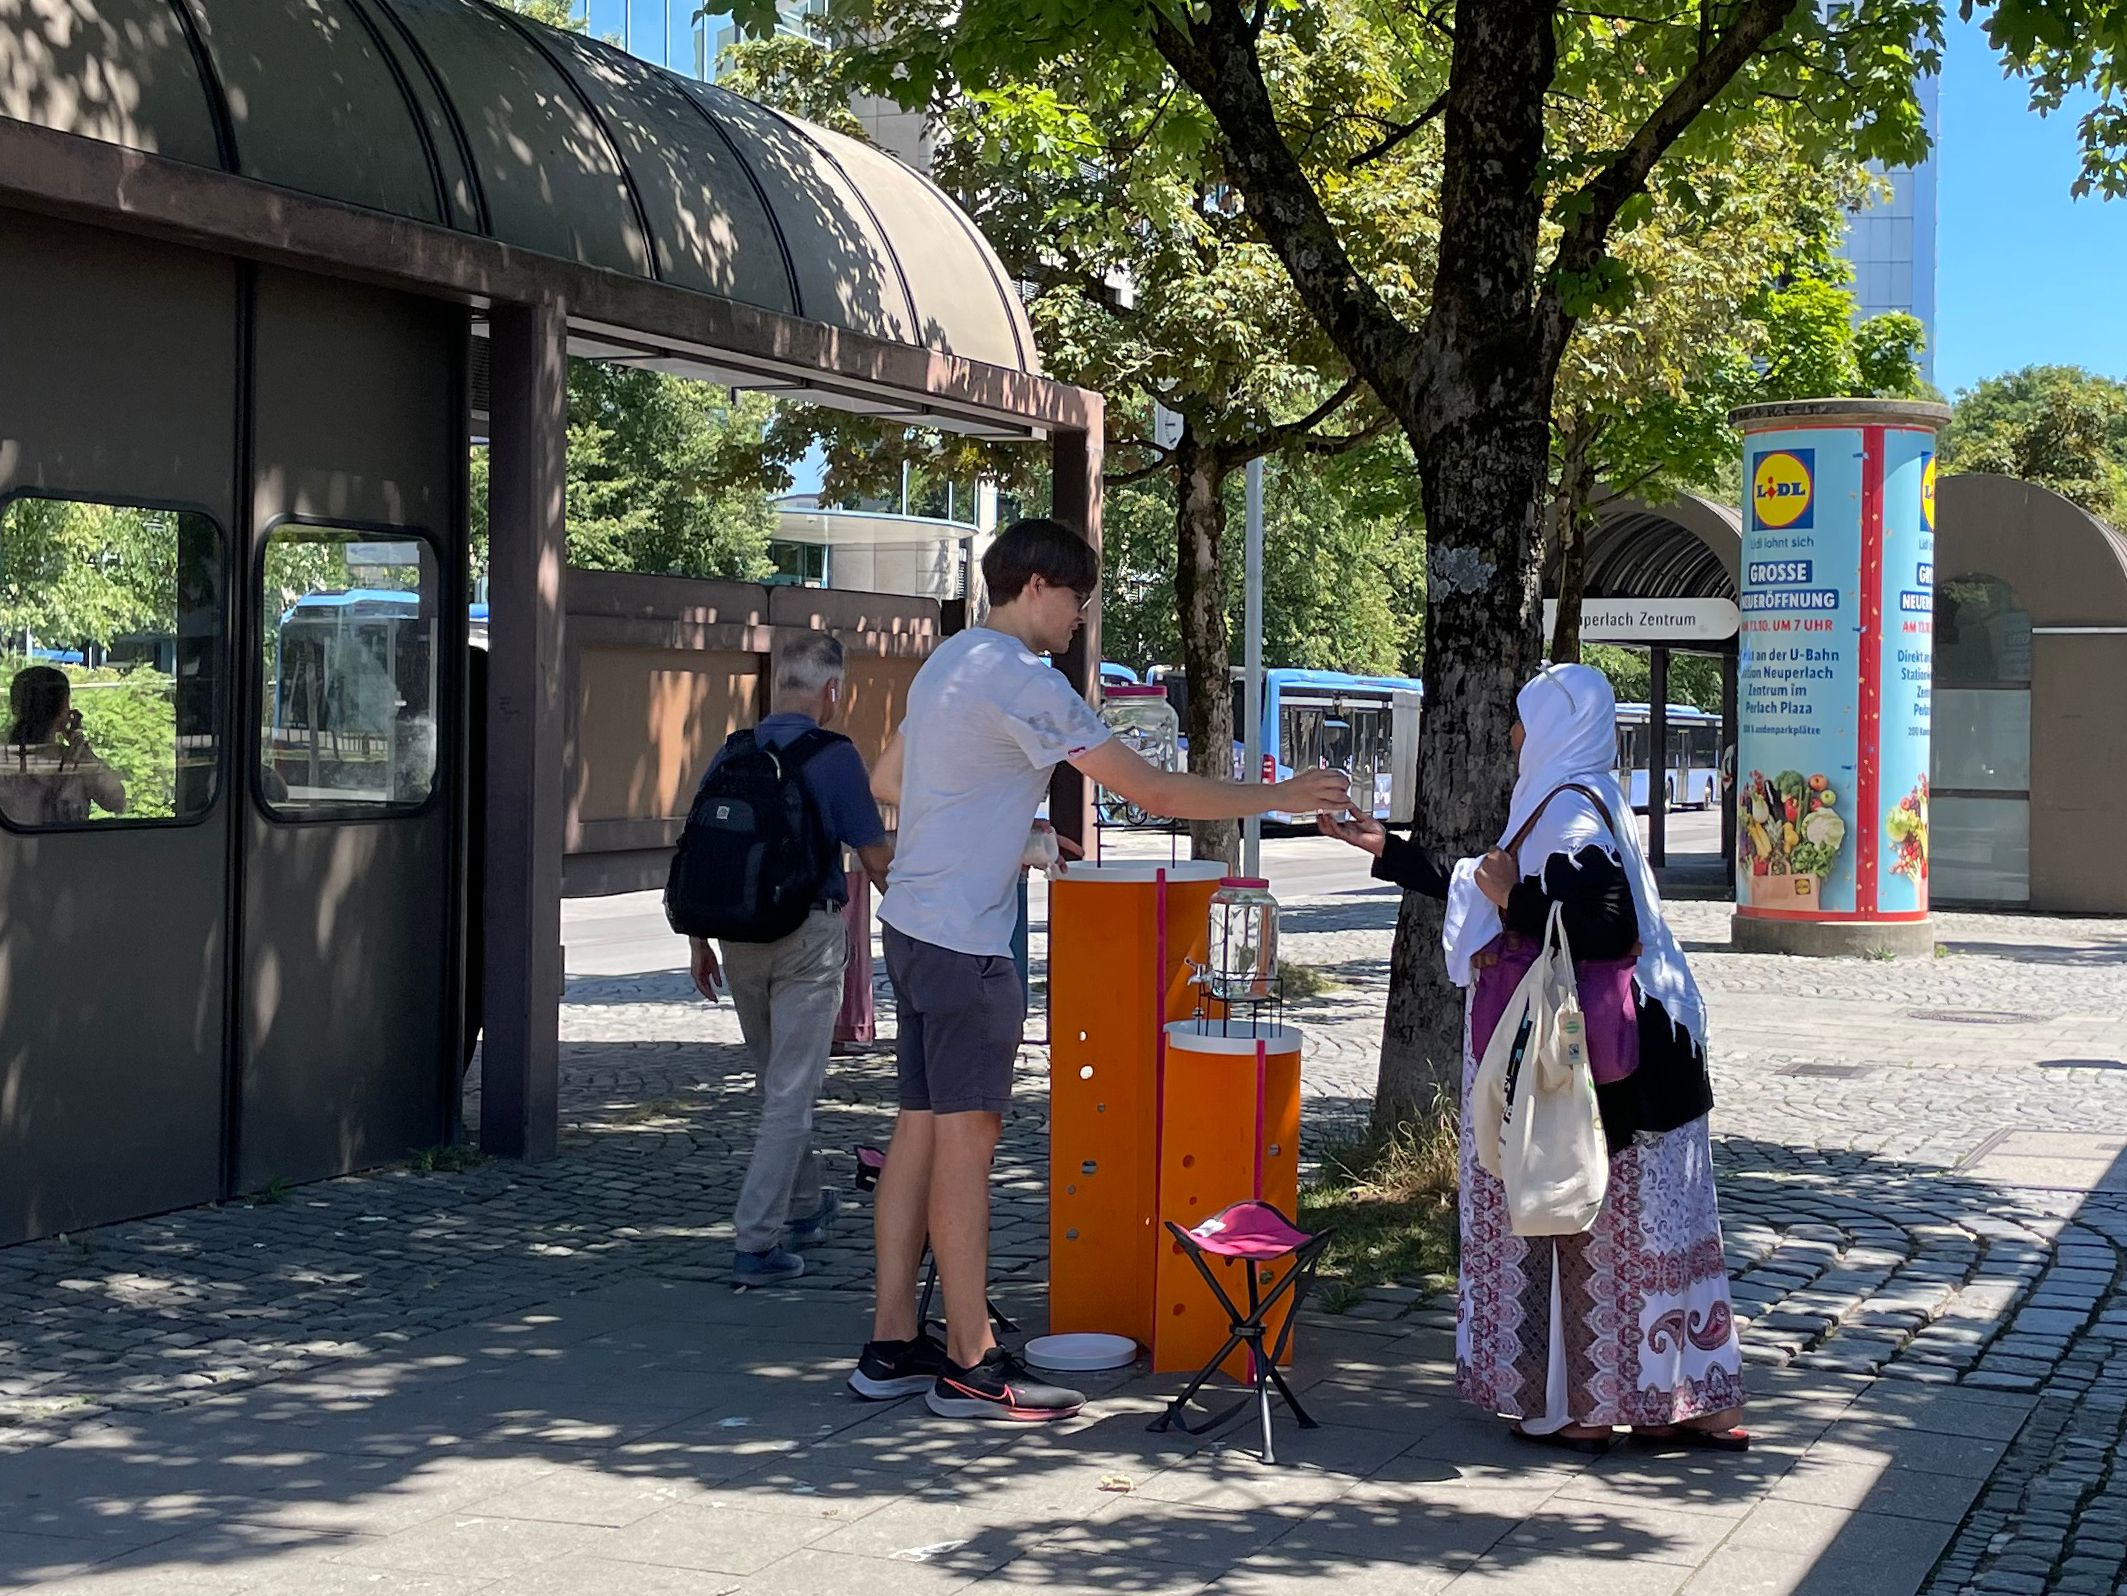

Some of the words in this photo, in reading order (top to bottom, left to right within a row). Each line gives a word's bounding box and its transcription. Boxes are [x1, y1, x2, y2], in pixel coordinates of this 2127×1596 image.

[1756, 476, 1806, 501] LIDL
[1764, 538, 1788, 549] lohnt
[1791, 536, 1814, 548] sich
[1750, 563, 1807, 582] GROSSE
[1639, 611, 1696, 627] Zentrum
[1773, 620, 1791, 631] UM
[1794, 620, 1801, 631] 7
[1804, 619, 1833, 631] UHR
[1902, 621, 1916, 633] AM
[1756, 651, 1767, 661] an
[1769, 648, 1787, 661] der
[1790, 648, 1840, 661] U-Bahn
[1897, 649, 1924, 663] Direkt
[1763, 666, 1834, 681] Neuperlach
[1748, 683, 1788, 696] Zentrum
[1791, 683, 1807, 696] im
[1745, 701, 1777, 714] Perlach
[1780, 701, 1813, 714] Plaza
